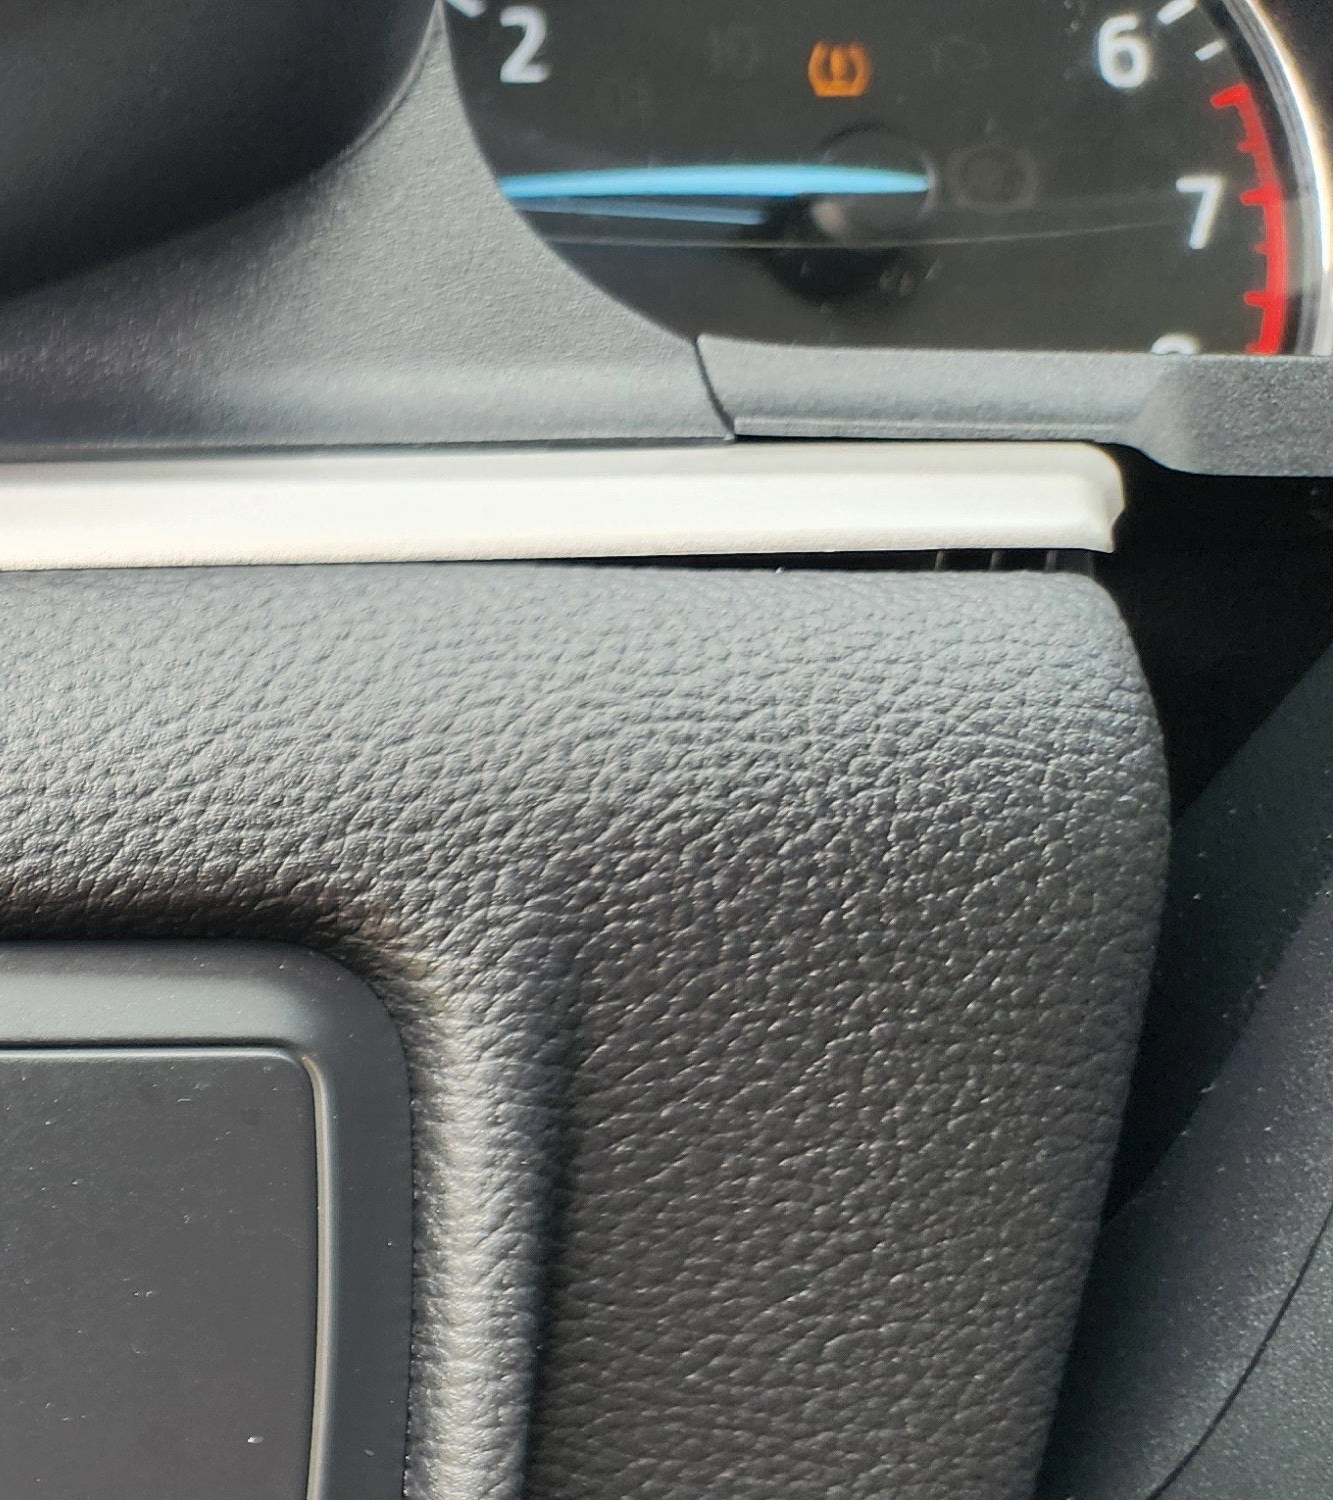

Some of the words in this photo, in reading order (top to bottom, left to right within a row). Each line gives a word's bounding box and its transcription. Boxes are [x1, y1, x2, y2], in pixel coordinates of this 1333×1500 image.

[500, 6, 549, 84] 2
[1097, 15, 1150, 90] 6
[1176, 176, 1224, 250] 7
